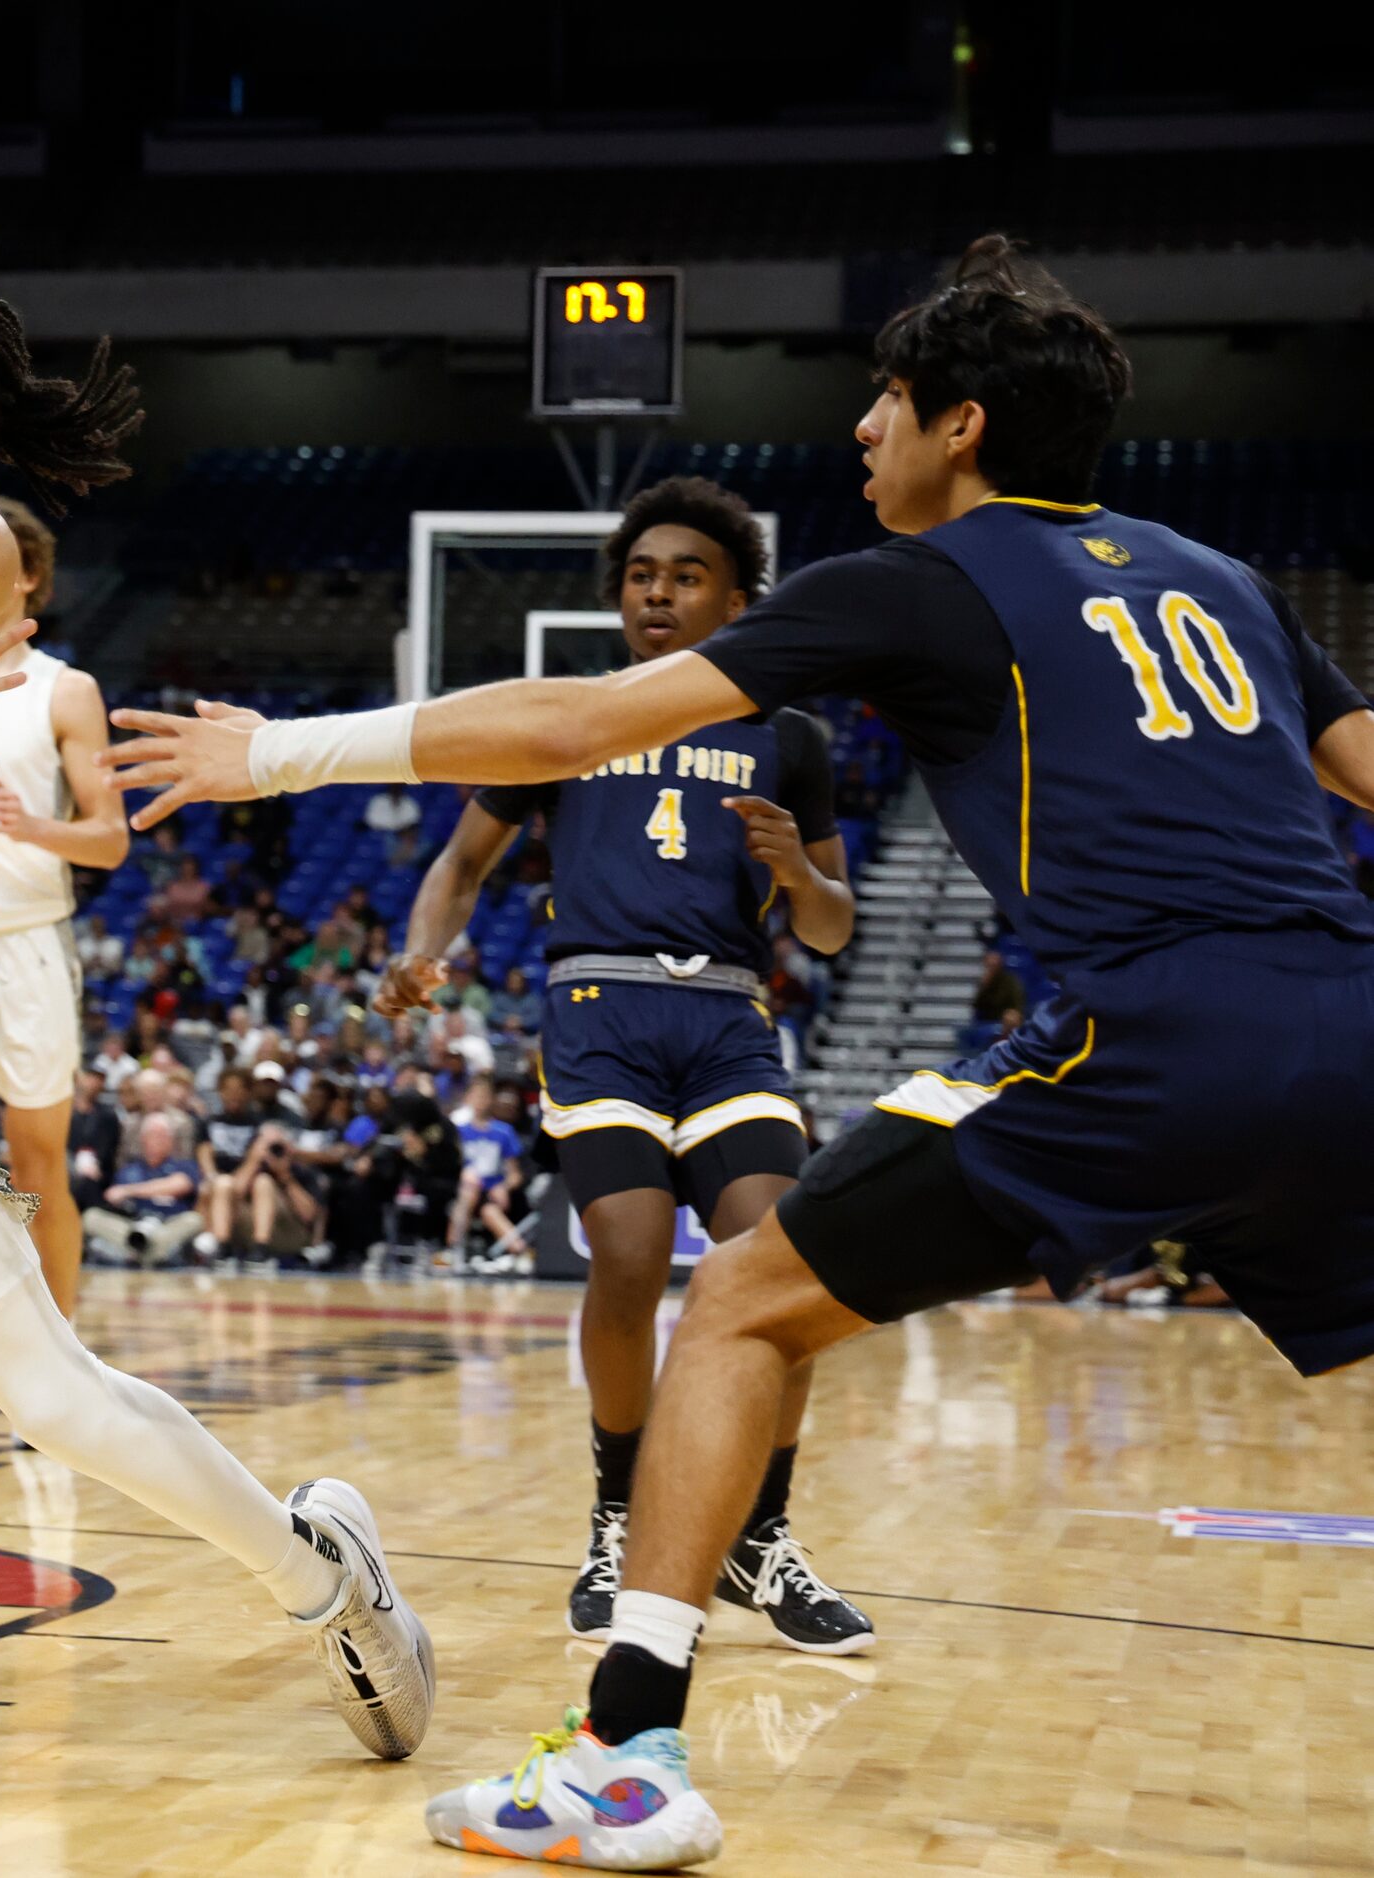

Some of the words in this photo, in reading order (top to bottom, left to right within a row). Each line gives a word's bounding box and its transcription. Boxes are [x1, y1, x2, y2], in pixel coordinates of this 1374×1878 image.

[565, 281, 646, 324] 17.7
[1081, 590, 1261, 741] 10
[579, 746, 665, 781] ONY
[677, 745, 757, 790] POINT
[645, 787, 688, 860] 4
